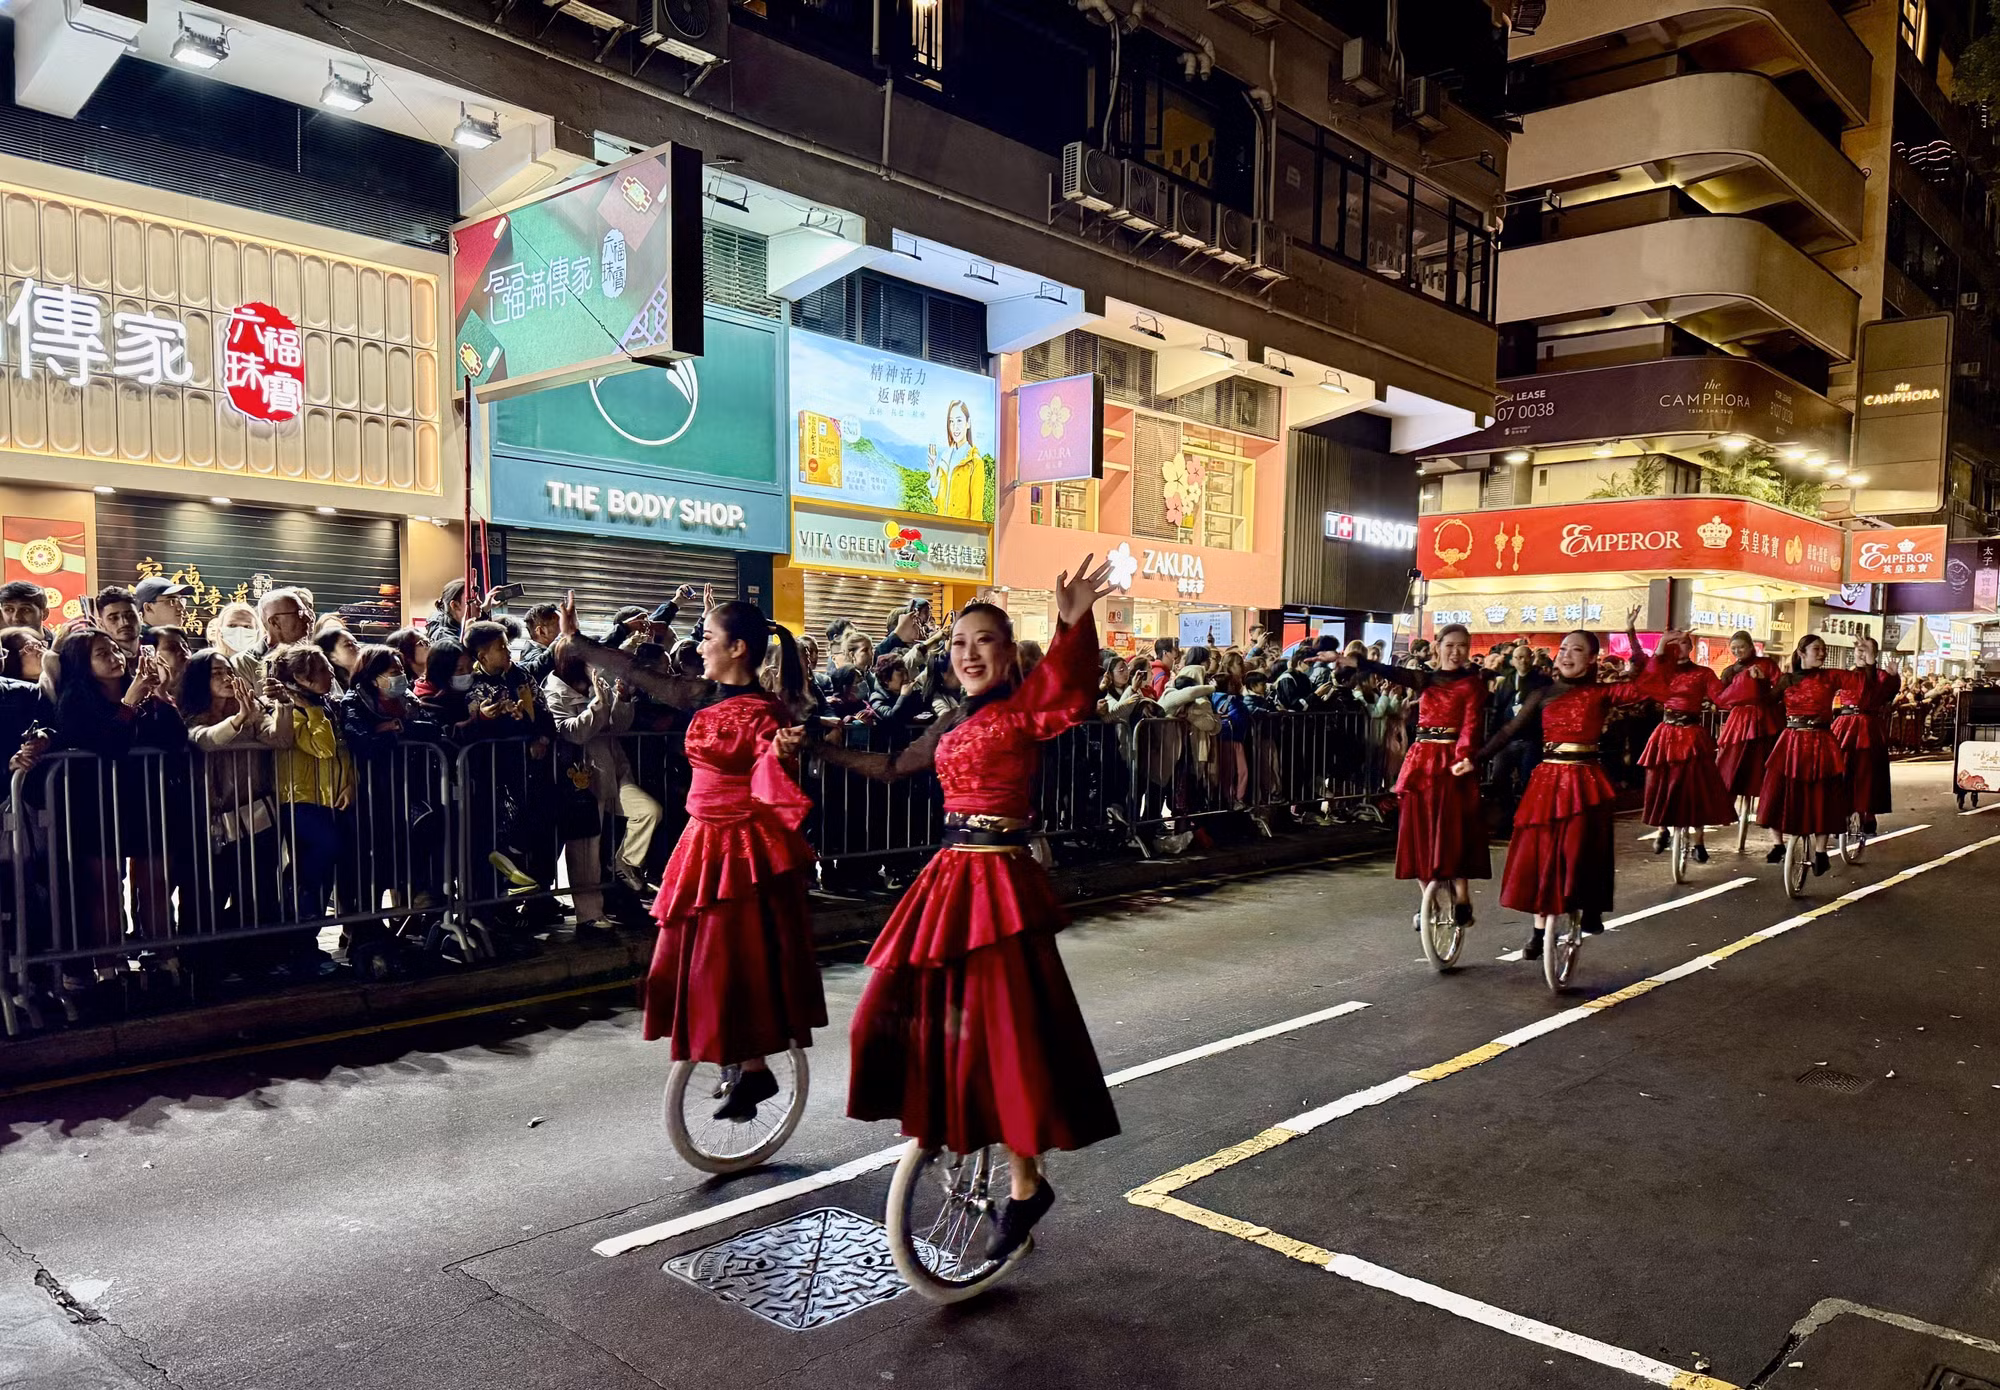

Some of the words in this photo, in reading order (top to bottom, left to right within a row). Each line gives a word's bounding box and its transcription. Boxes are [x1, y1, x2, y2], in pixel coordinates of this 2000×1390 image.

[0, 277, 193, 387] 傳家
[870, 363, 926, 386] 精神活力
[1704, 378, 1722, 390] the
[1516, 389, 1547, 401] LEASE
[1863, 389, 1940, 406] CAMPHORA
[1895, 382, 1911, 392] the
[1497, 406, 1515, 421] 07
[1518, 402, 1555, 419] 0038
[1659, 393, 1751, 408] CAMPHORA
[546, 481, 601, 512] THE
[608, 489, 676, 519] BODY
[799, 530, 833, 549] VITA
[839, 534, 886, 553] GREEN
[1353, 515, 1418, 550] TISSOT
[1560, 523, 1682, 557] EMPEROR
[1740, 528, 1780, 559] 英皇珠寶
[1143, 549, 1204, 579] ZAKURA
[1859, 542, 1934, 570] EMPEROR
[1883, 563, 1928, 574] 英皇珠寶
[1520, 603, 1603, 623] 英皇珠寶
